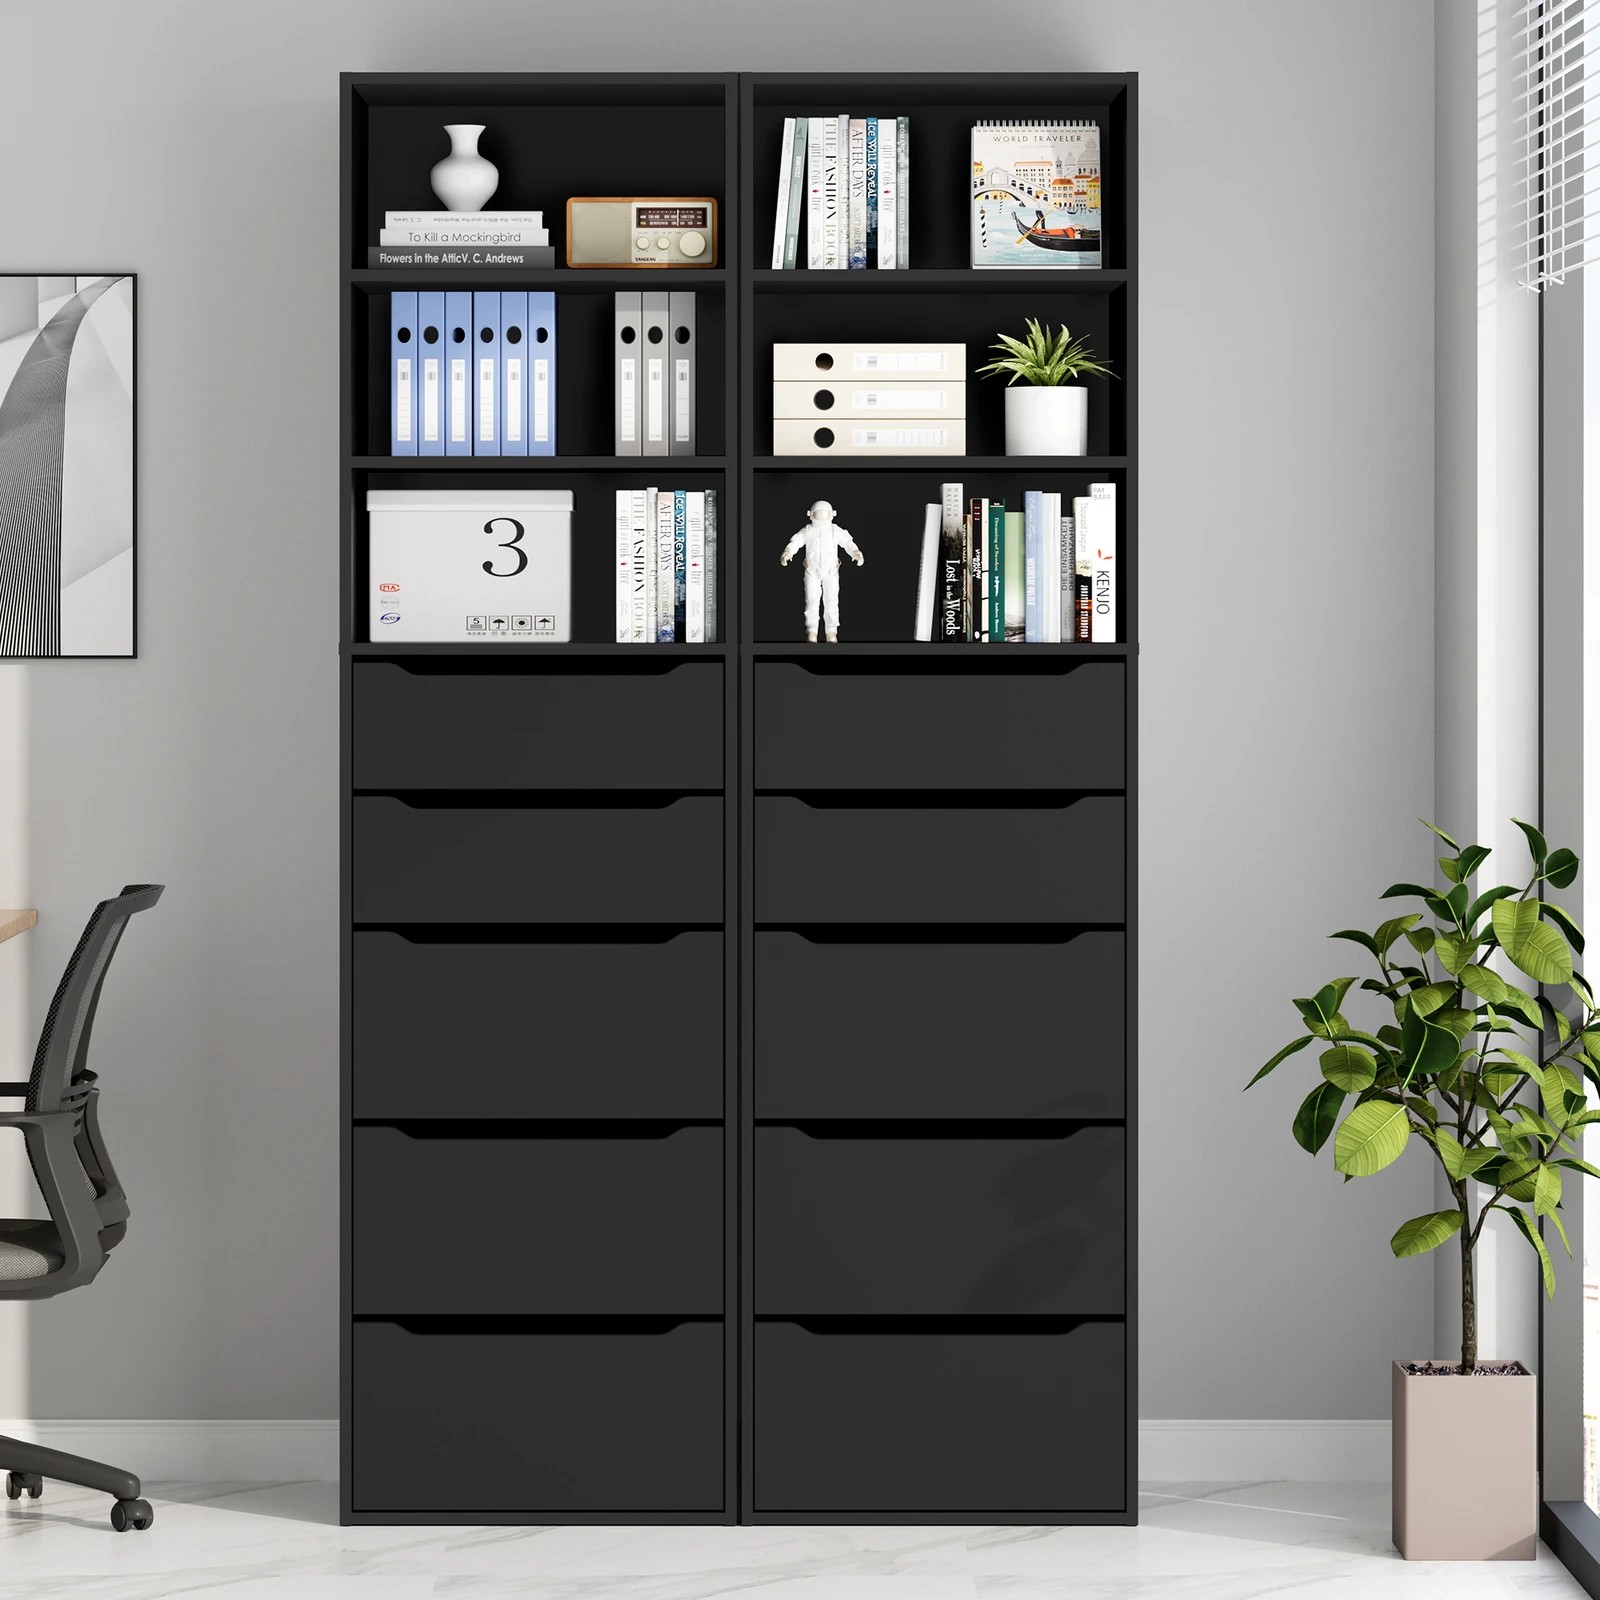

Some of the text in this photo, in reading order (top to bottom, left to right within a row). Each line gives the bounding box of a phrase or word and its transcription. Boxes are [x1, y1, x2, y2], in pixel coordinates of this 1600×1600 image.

[852, 129, 863, 198] AFTER DAYS
[826, 120, 836, 266] THE FASHION BOOK
[380, 253, 412, 263] Flowers
[414, 253, 422, 263] in
[424, 253, 439, 263] the
[473, 253, 483, 263] C.
[485, 253, 524, 263] Andrews
[408, 232, 421, 242] To
[424, 232, 437, 242] Kill
[452, 232, 521, 244] Mockingbird
[634, 493, 644, 524] THE
[482, 517, 528, 577] 3
[660, 502, 672, 571] AFTER DAYS
[634, 528, 644, 592] FASHION
[946, 559, 960, 583] Lost
[1096, 570, 1110, 615] KENJO
[946, 599, 961, 635] Woods
